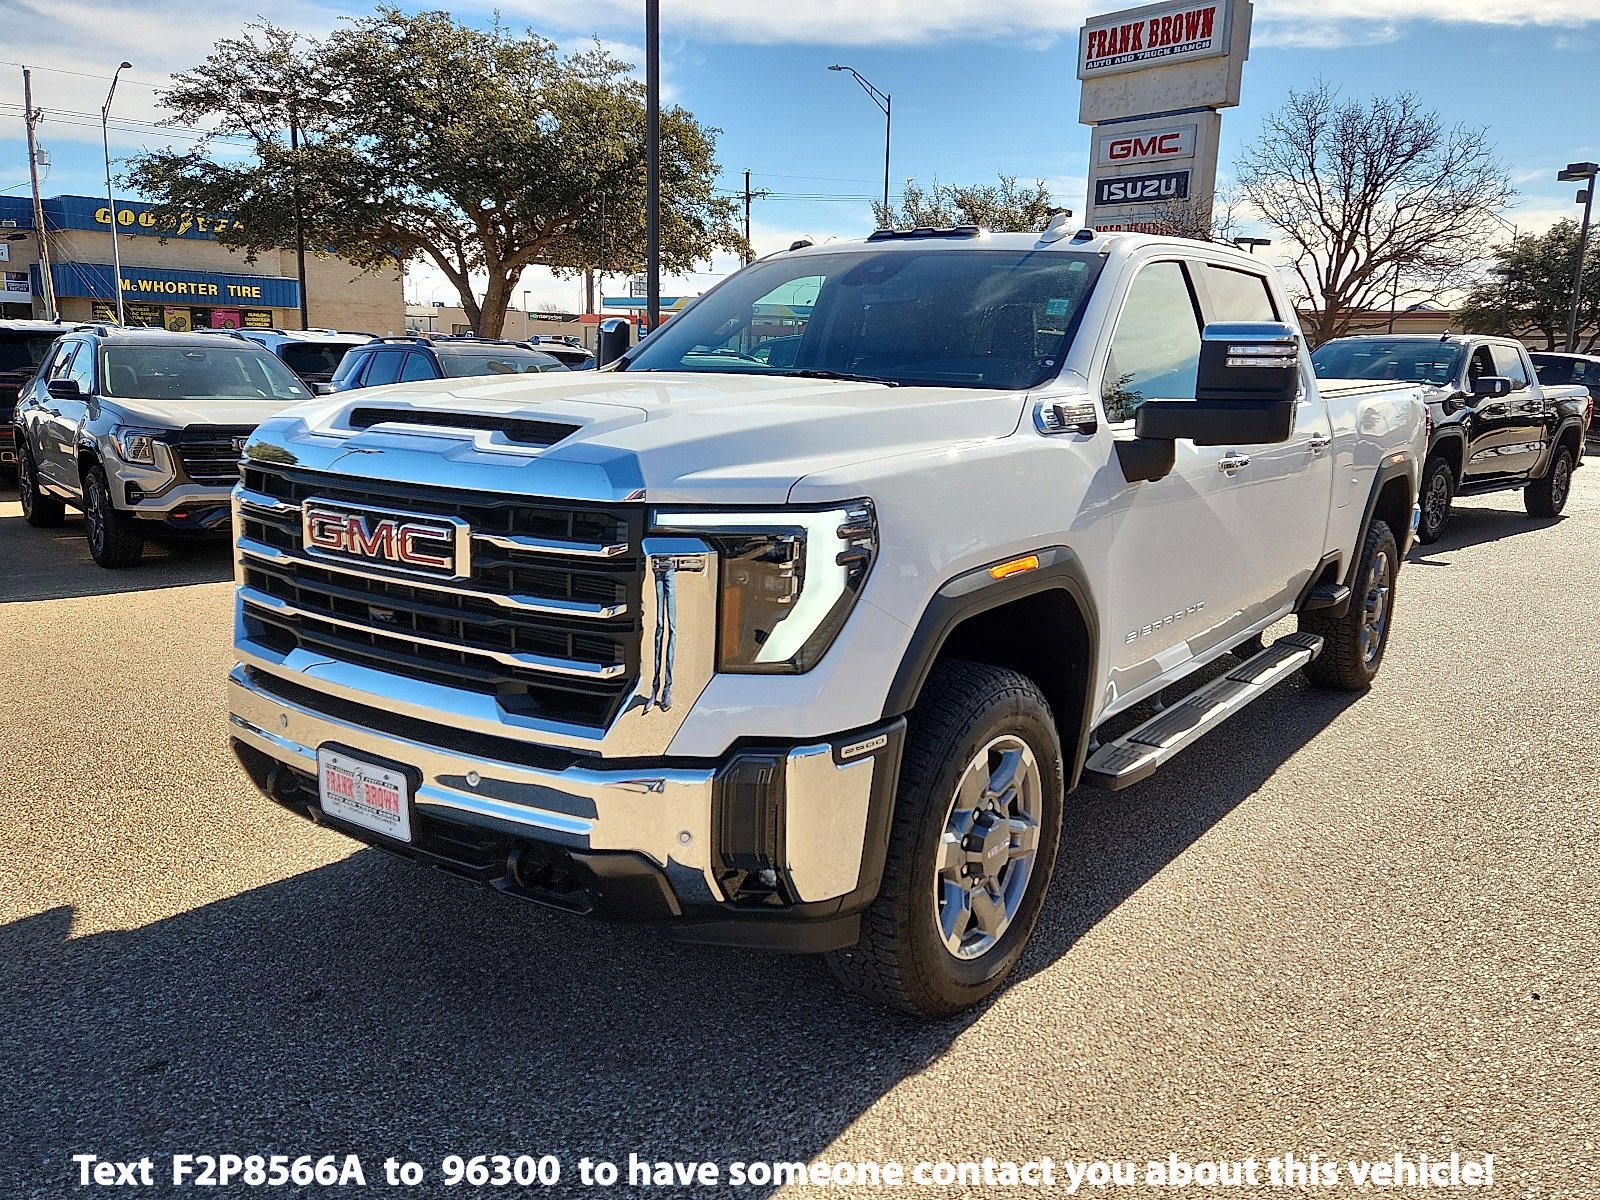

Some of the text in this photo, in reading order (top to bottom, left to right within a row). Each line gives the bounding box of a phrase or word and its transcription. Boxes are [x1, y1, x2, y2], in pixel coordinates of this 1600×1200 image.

[1087, 7, 1216, 60] FRANK BROWN
[1086, 40, 1210, 69] AUTO AND TRUCK RANCH
[1109, 133, 1180, 160] GMC
[1103, 178, 1177, 201] ISUZU
[227, 285, 261, 298] TIRE
[307, 508, 453, 570] GMC
[1124, 600, 1206, 645] SIERRA HD
[325, 769, 355, 800] FRANK
[364, 783, 400, 816] BROWN
